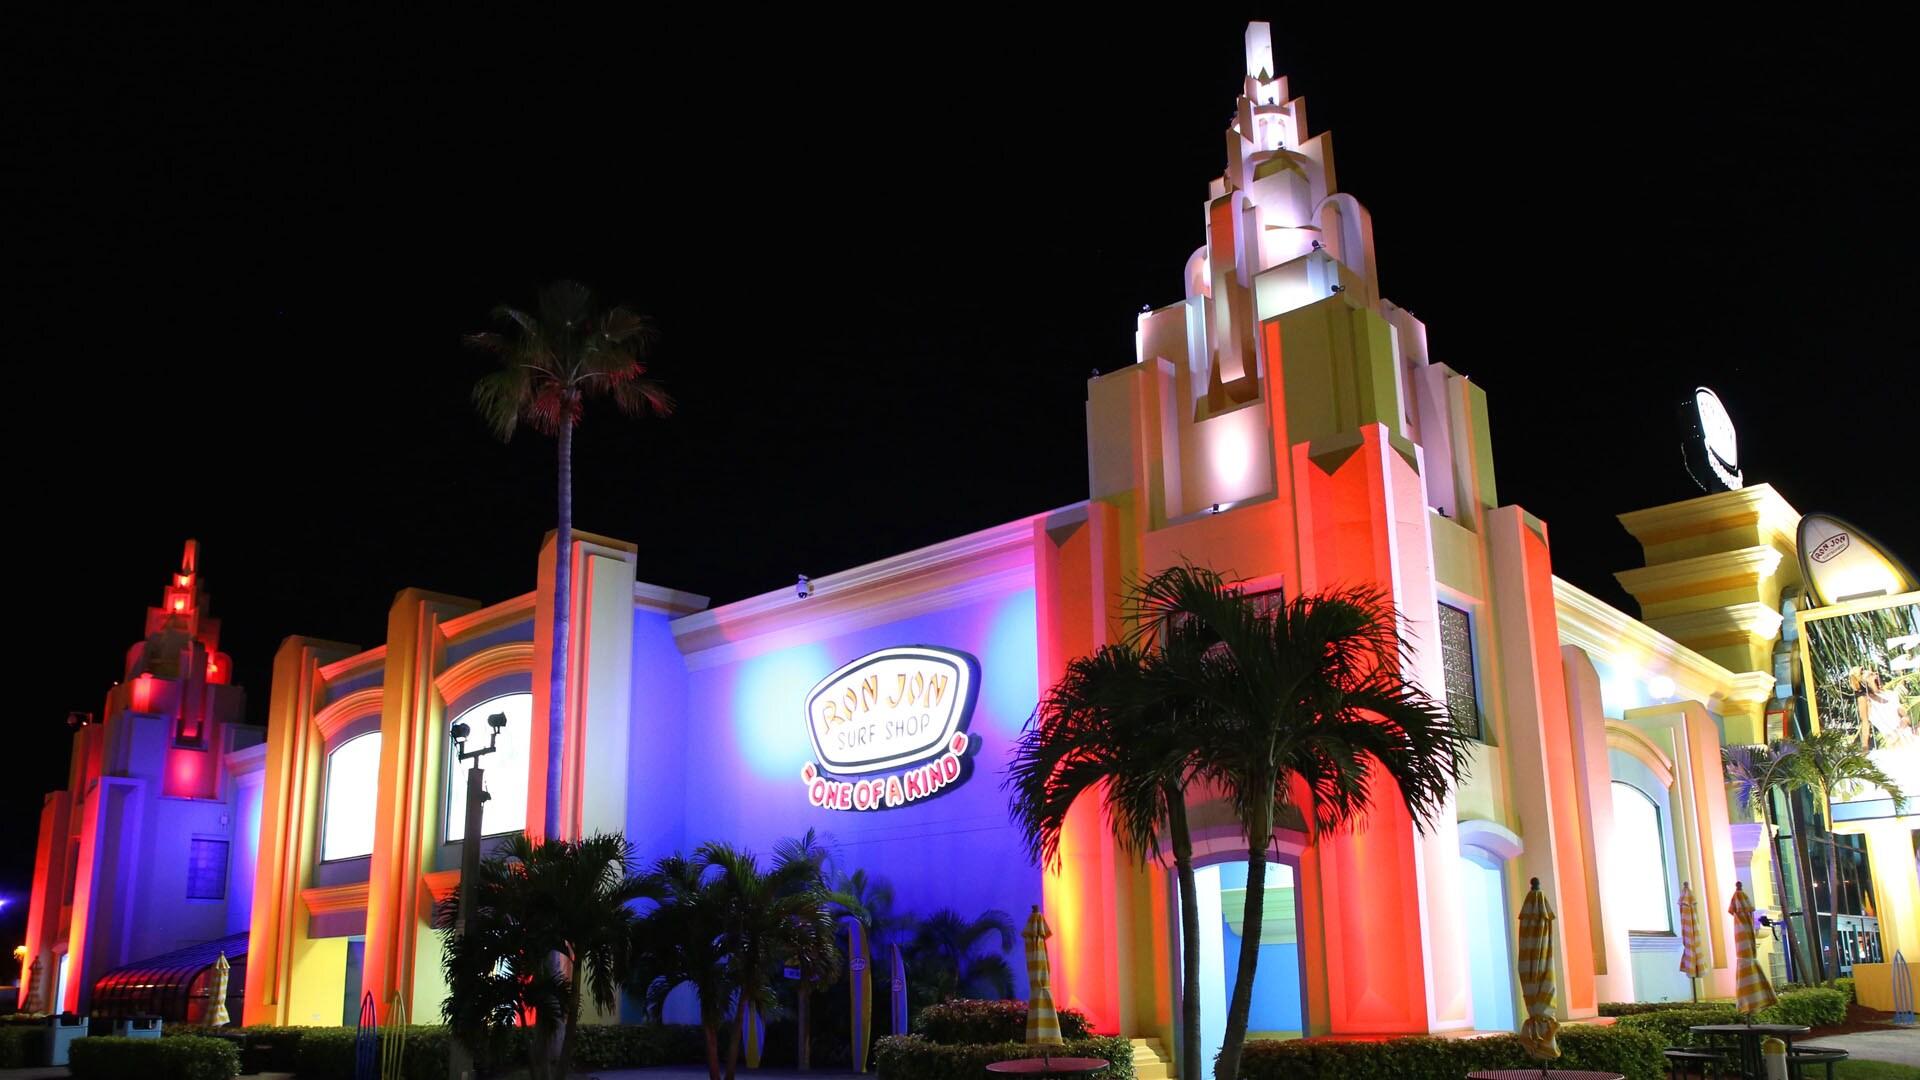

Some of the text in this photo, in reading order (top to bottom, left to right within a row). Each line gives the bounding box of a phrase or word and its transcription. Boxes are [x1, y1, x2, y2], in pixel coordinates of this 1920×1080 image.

[1815, 543, 1829, 559] RON
[1830, 535, 1846, 547] JON
[822, 671, 948, 735] RON JON
[837, 713, 930, 751] SURF SHOP
[854, 779, 883, 809] OF
[887, 777, 903, 807] A
